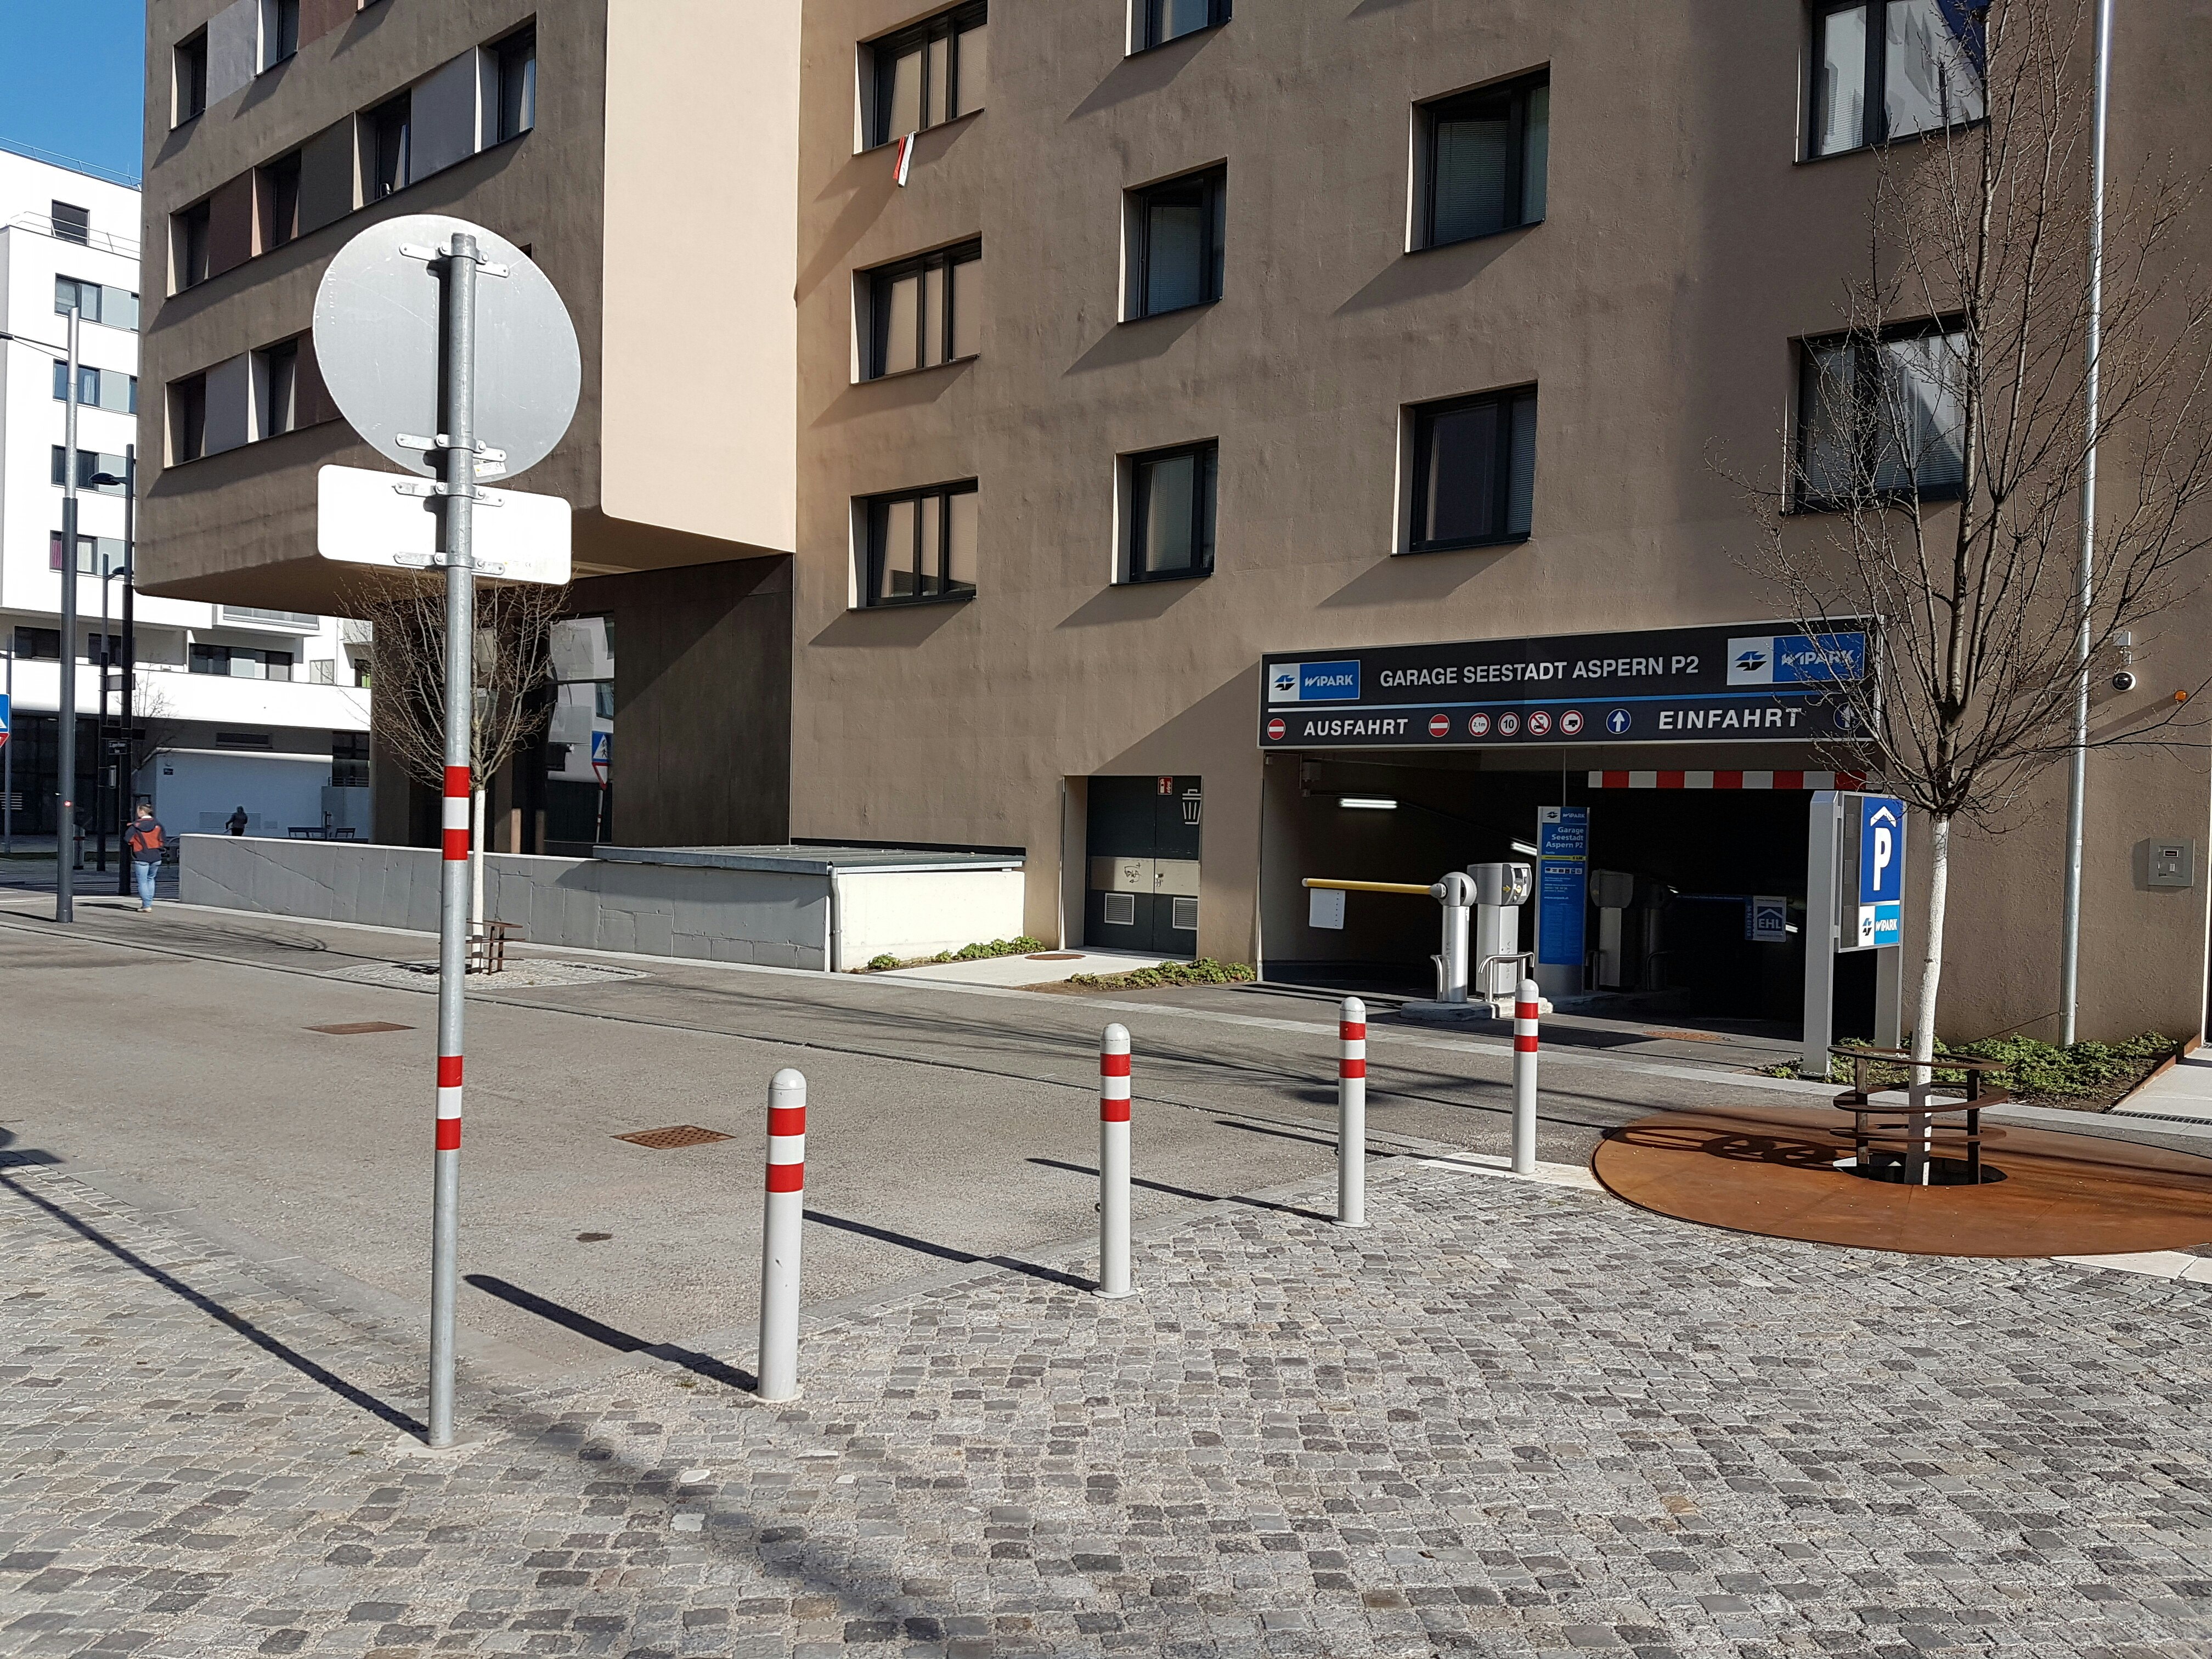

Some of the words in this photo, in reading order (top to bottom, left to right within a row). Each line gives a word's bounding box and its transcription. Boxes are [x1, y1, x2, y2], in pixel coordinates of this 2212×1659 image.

[1380, 667, 1458, 686] GARAGE
[1463, 662, 1567, 684] SEESTADT
[1572, 657, 1663, 679] ASPERN
[1672, 656, 1699, 674] P2
[1503, 719, 1514, 729] 10
[1659, 708, 1802, 729] EINFAHRT
[1304, 719, 1408, 736] AUSFAHRT
[1558, 826, 1584, 834] Garage
[1545, 841, 1573, 849] Aspern
[1873, 827, 1892, 891] P
[1758, 918, 1781, 929] EHL
